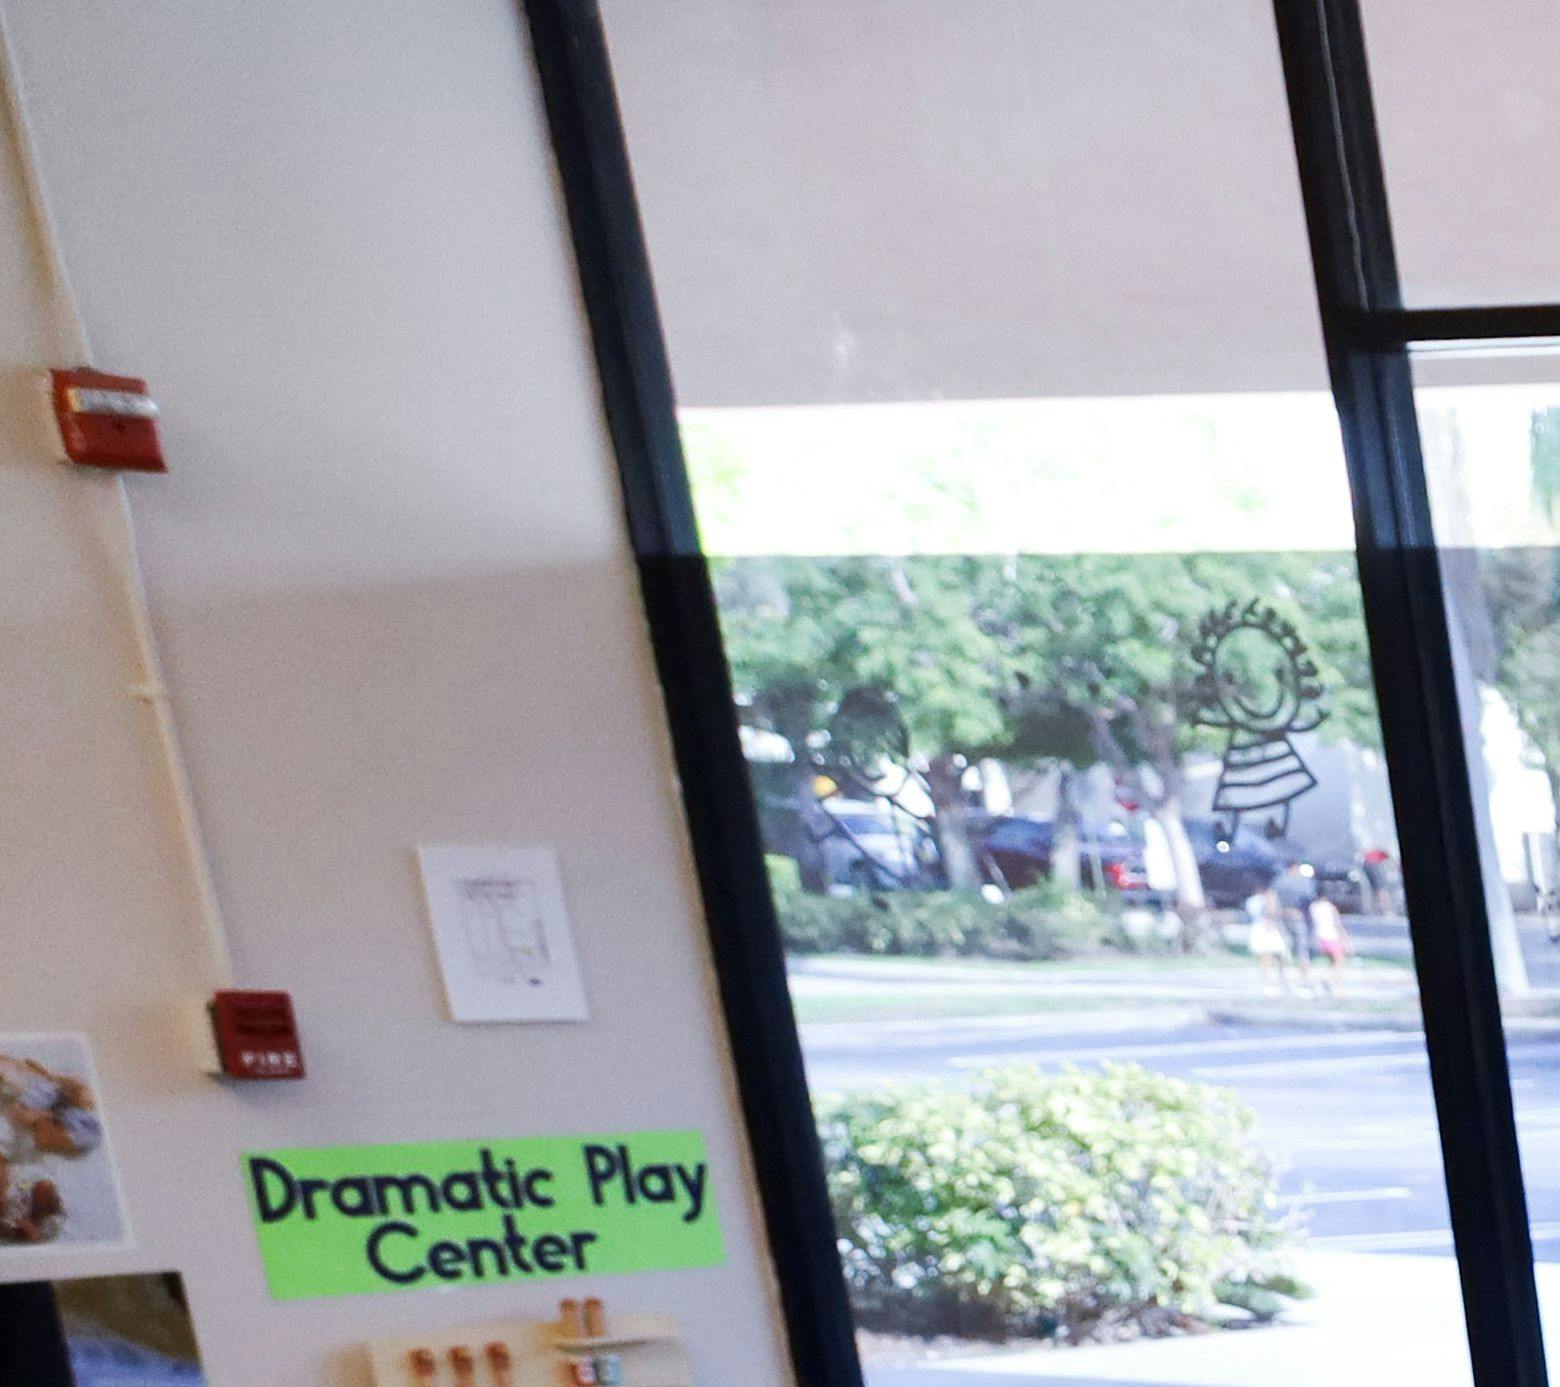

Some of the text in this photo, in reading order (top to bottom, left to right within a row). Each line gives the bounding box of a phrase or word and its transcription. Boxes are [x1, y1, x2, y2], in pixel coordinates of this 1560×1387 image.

[248, 1144, 706, 1224] Dramatic Play
[366, 1215, 596, 1284] Center
